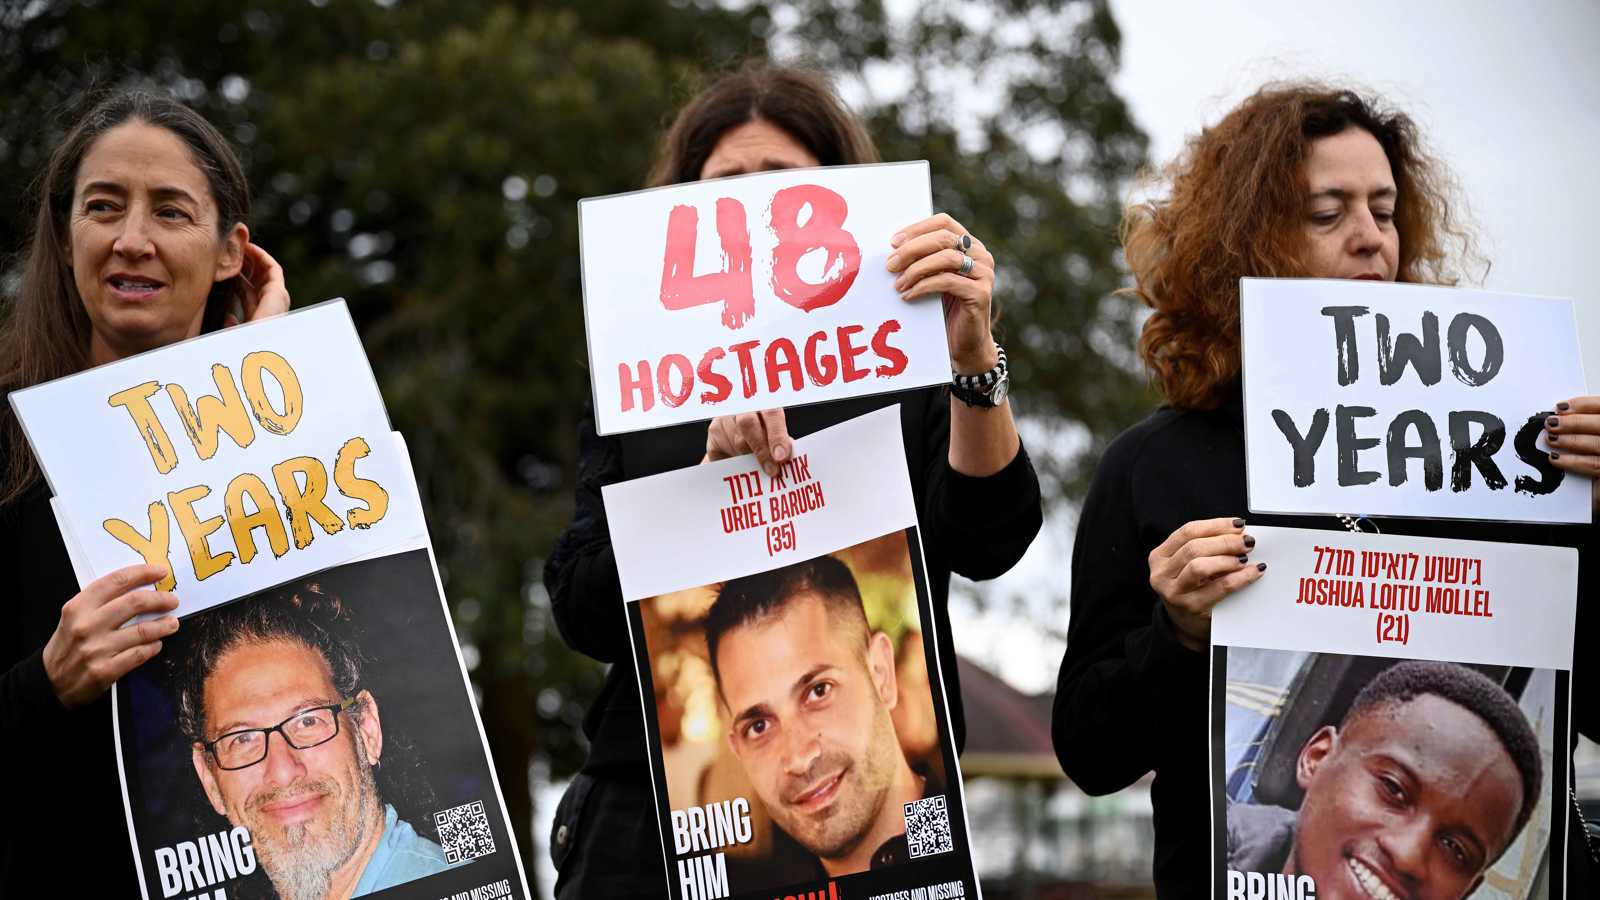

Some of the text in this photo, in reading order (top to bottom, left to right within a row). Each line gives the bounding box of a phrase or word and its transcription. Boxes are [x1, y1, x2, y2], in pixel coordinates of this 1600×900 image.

[660, 184, 862, 330] 48
[618, 319, 908, 412] HOSTAGES
[1321, 305, 1504, 387] TWO
[108, 351, 303, 474] TWO
[1272, 404, 1566, 498] YEARS
[720, 481, 825, 534] URIEL BARUCH
[723, 470, 763, 504] ברוך
[103, 437, 389, 593] YEARS
[766, 521, 796, 556] (35)
[1313, 545, 1355, 577] מולל
[1361, 551, 1420, 581] לואיטו
[1296, 577, 1493, 617] JOSHUA LOITU MOLLEL
[1376, 612, 1409, 645] (21)
[671, 797, 752, 855] BRING
[155, 826, 256, 899] BRING
[677, 853, 730, 900] HIM
[1227, 870, 1315, 900] BRING
[470, 879, 511, 900] MISSING
[928, 880, 965, 900] MISSING
